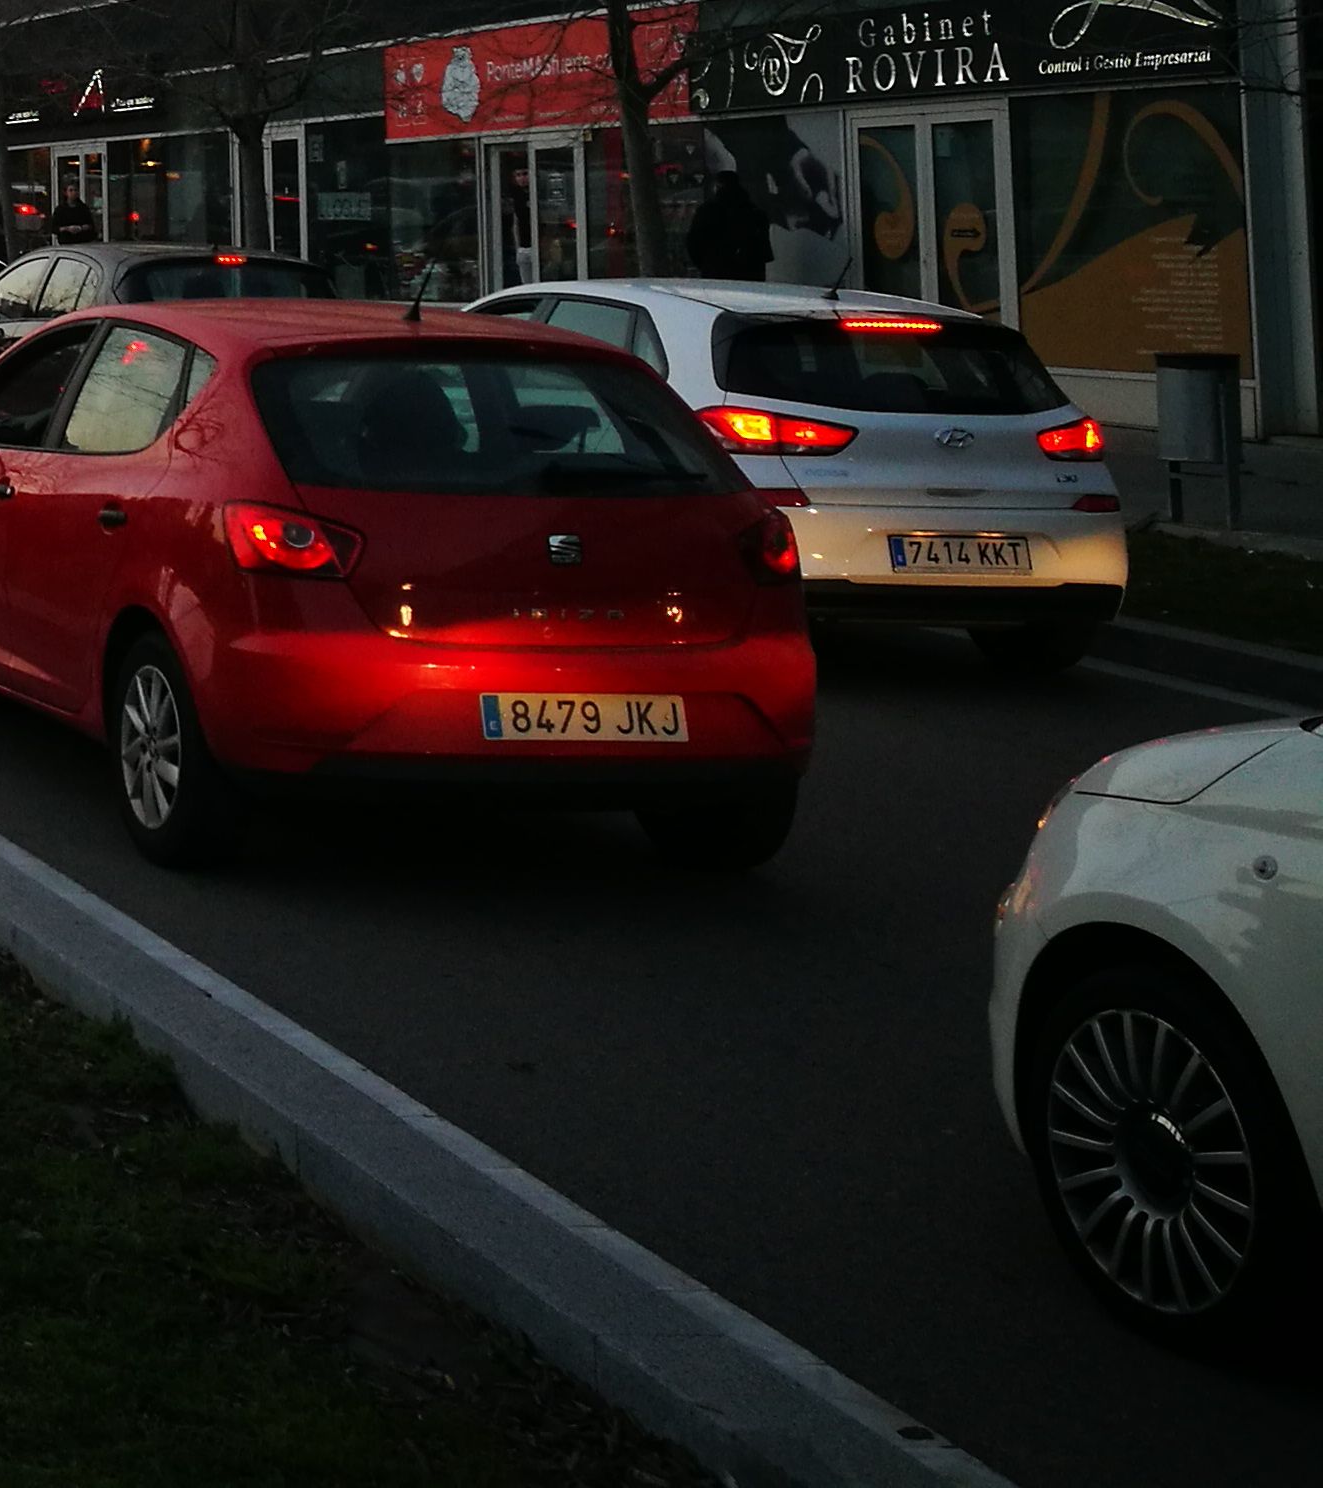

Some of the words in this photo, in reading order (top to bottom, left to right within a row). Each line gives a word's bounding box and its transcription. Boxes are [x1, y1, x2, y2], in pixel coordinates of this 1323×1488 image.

[858, 9, 993, 49] Gabinet
[845, 42, 1010, 94] ROVIRA
[1038, 56, 1082, 75] Control
[909, 542, 971, 565] 7414
[978, 542, 1021, 566] KKT
[511, 700, 601, 734] 8479
[616, 701, 679, 734] JKJ
